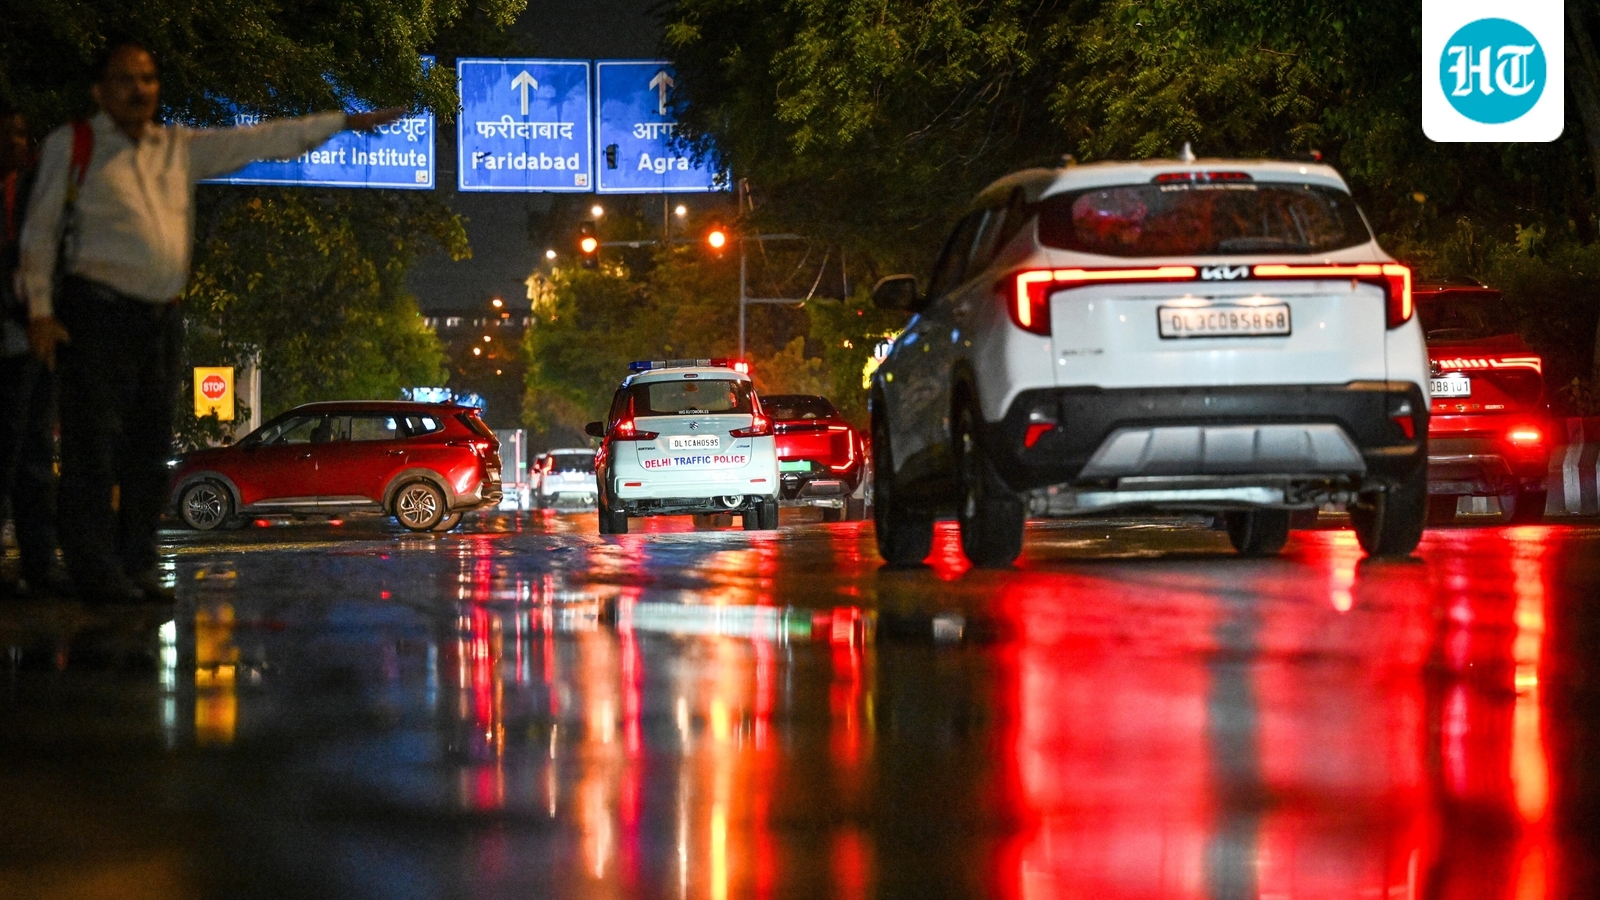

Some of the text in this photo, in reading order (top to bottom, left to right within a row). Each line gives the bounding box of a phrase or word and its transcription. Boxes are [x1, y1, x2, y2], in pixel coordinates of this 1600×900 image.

[475, 114, 574, 140] फरीदाबाद
[632, 122, 689, 140] आग
[352, 147, 427, 167] Institute
[471, 152, 580, 170] Faridabad
[637, 153, 689, 174] Agra
[203, 382, 225, 392] STOP
[674, 439, 719, 448] DL1CAH0595
[645, 455, 746, 469] DELHI TRAFFIC POLICE
